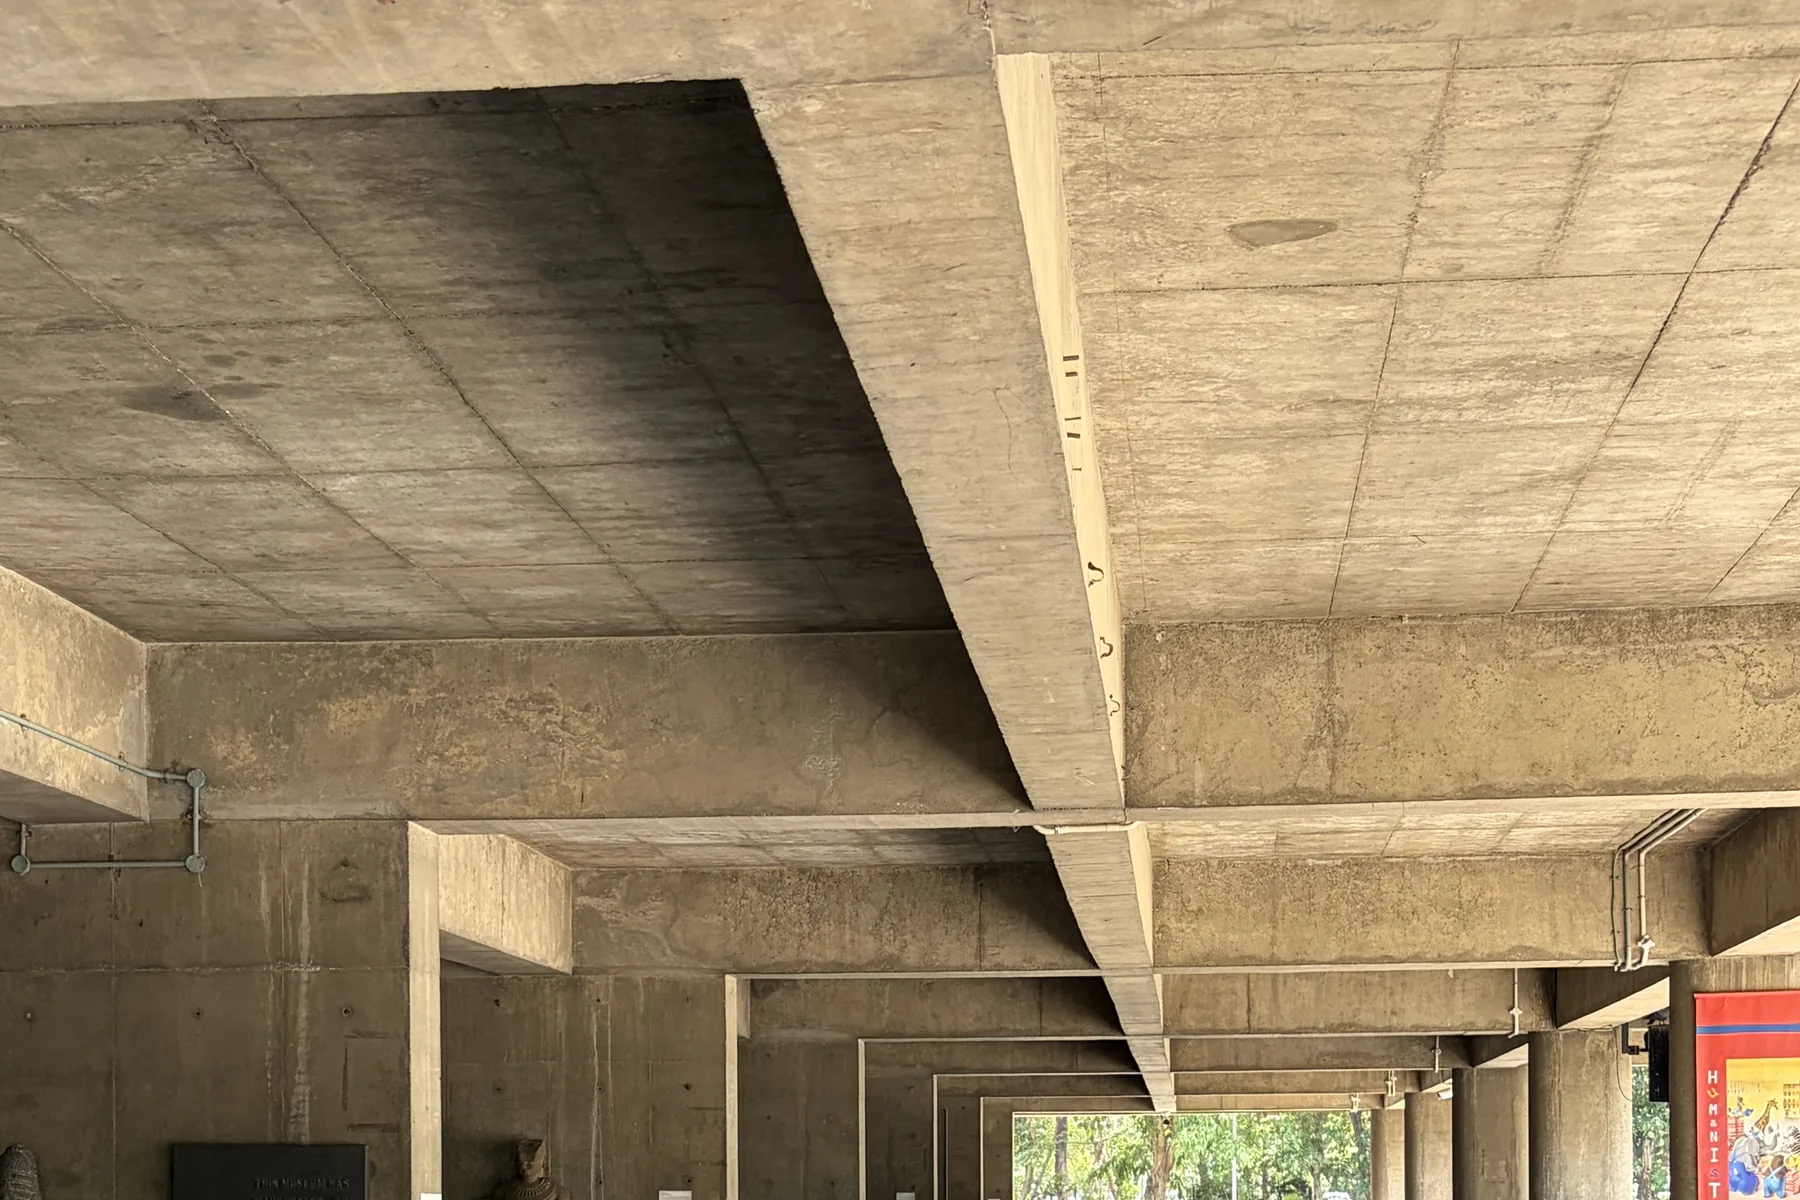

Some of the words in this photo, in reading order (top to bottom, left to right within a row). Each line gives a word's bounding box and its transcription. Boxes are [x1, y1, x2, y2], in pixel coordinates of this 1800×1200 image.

[254, 1178, 279, 1190] THIS
[281, 1178, 326, 1190] MUSEUM
[328, 1178, 350, 1190] WAS
